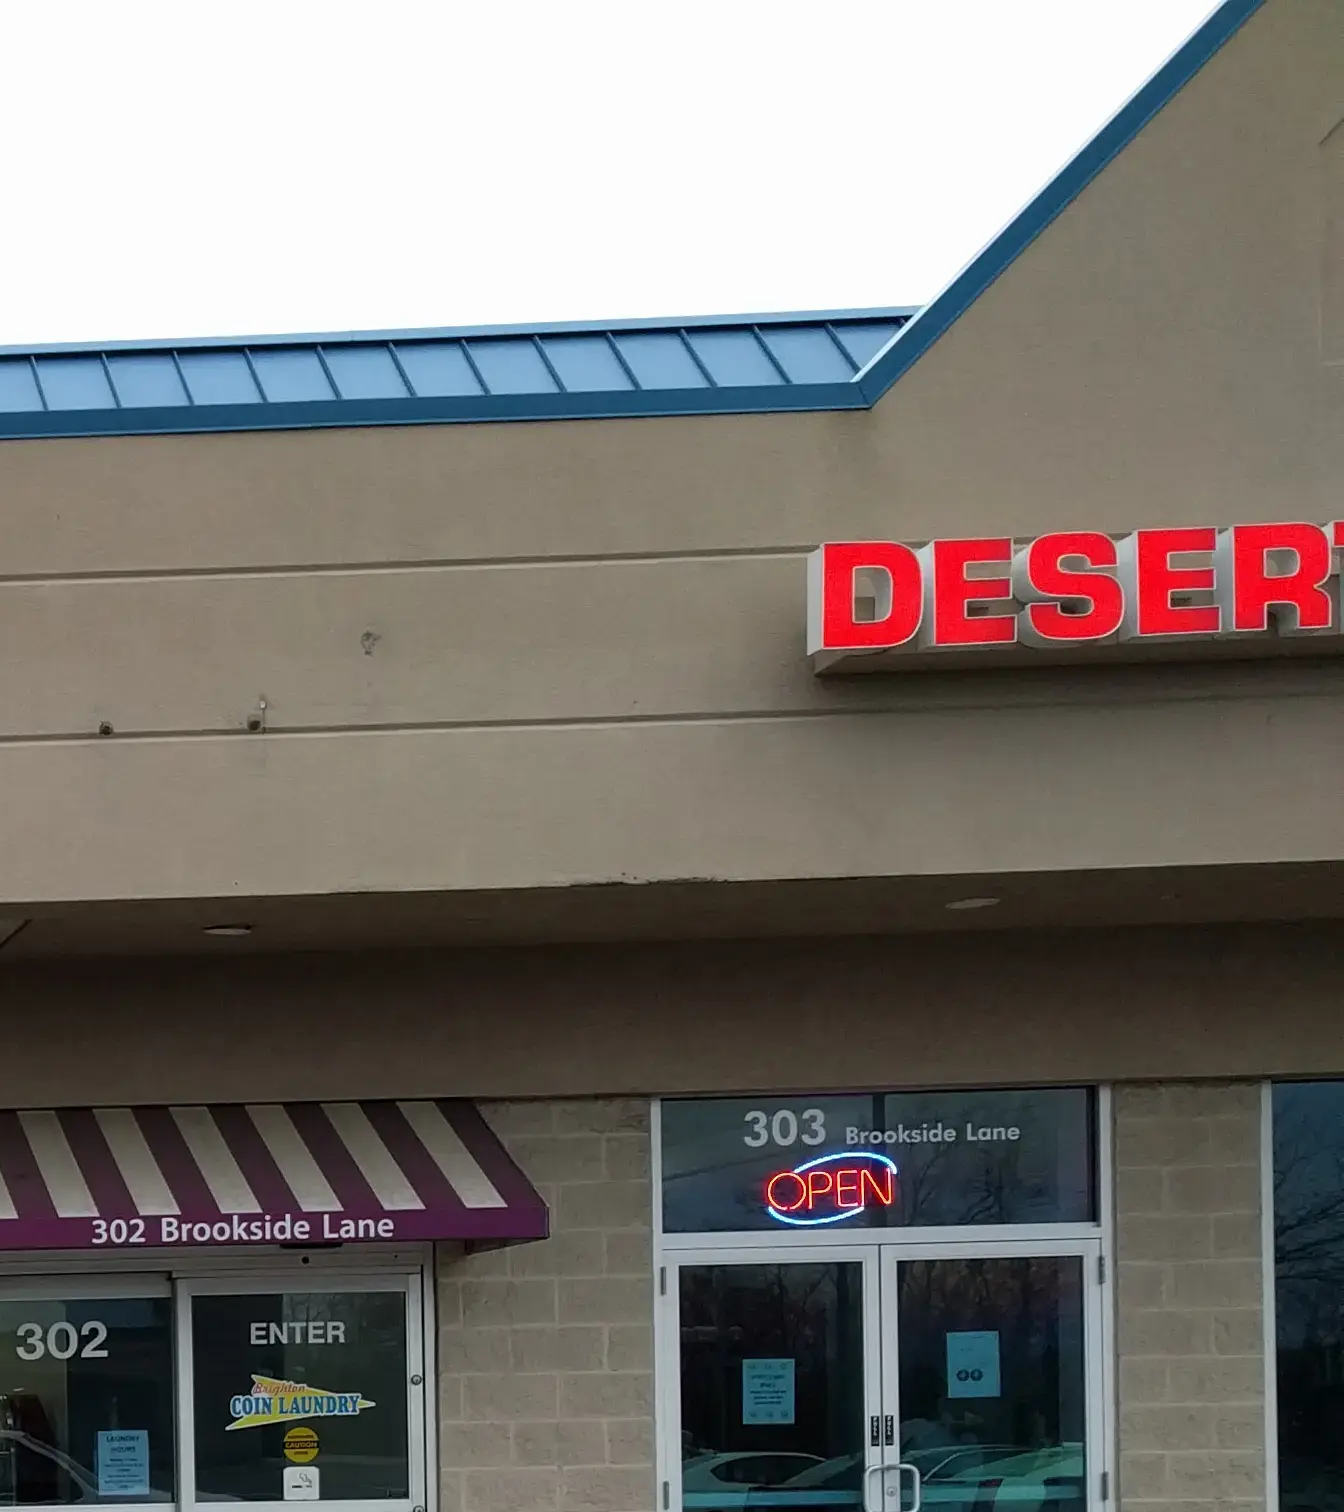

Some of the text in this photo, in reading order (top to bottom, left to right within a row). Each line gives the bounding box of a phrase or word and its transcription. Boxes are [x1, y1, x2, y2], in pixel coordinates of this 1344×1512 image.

[820, 520, 1344, 650] DESER
[743, 1108, 1021, 1148] 303 Brookside Lane
[767, 1168, 894, 1211] OPEN
[91, 1214, 395, 1244] 302 Brookside Lane
[16, 1320, 109, 1361] 302
[250, 1321, 346, 1345] ENTER
[231, 1395, 361, 1416] COIN LAUNDRY
[254, 1382, 306, 1398] Brighton
